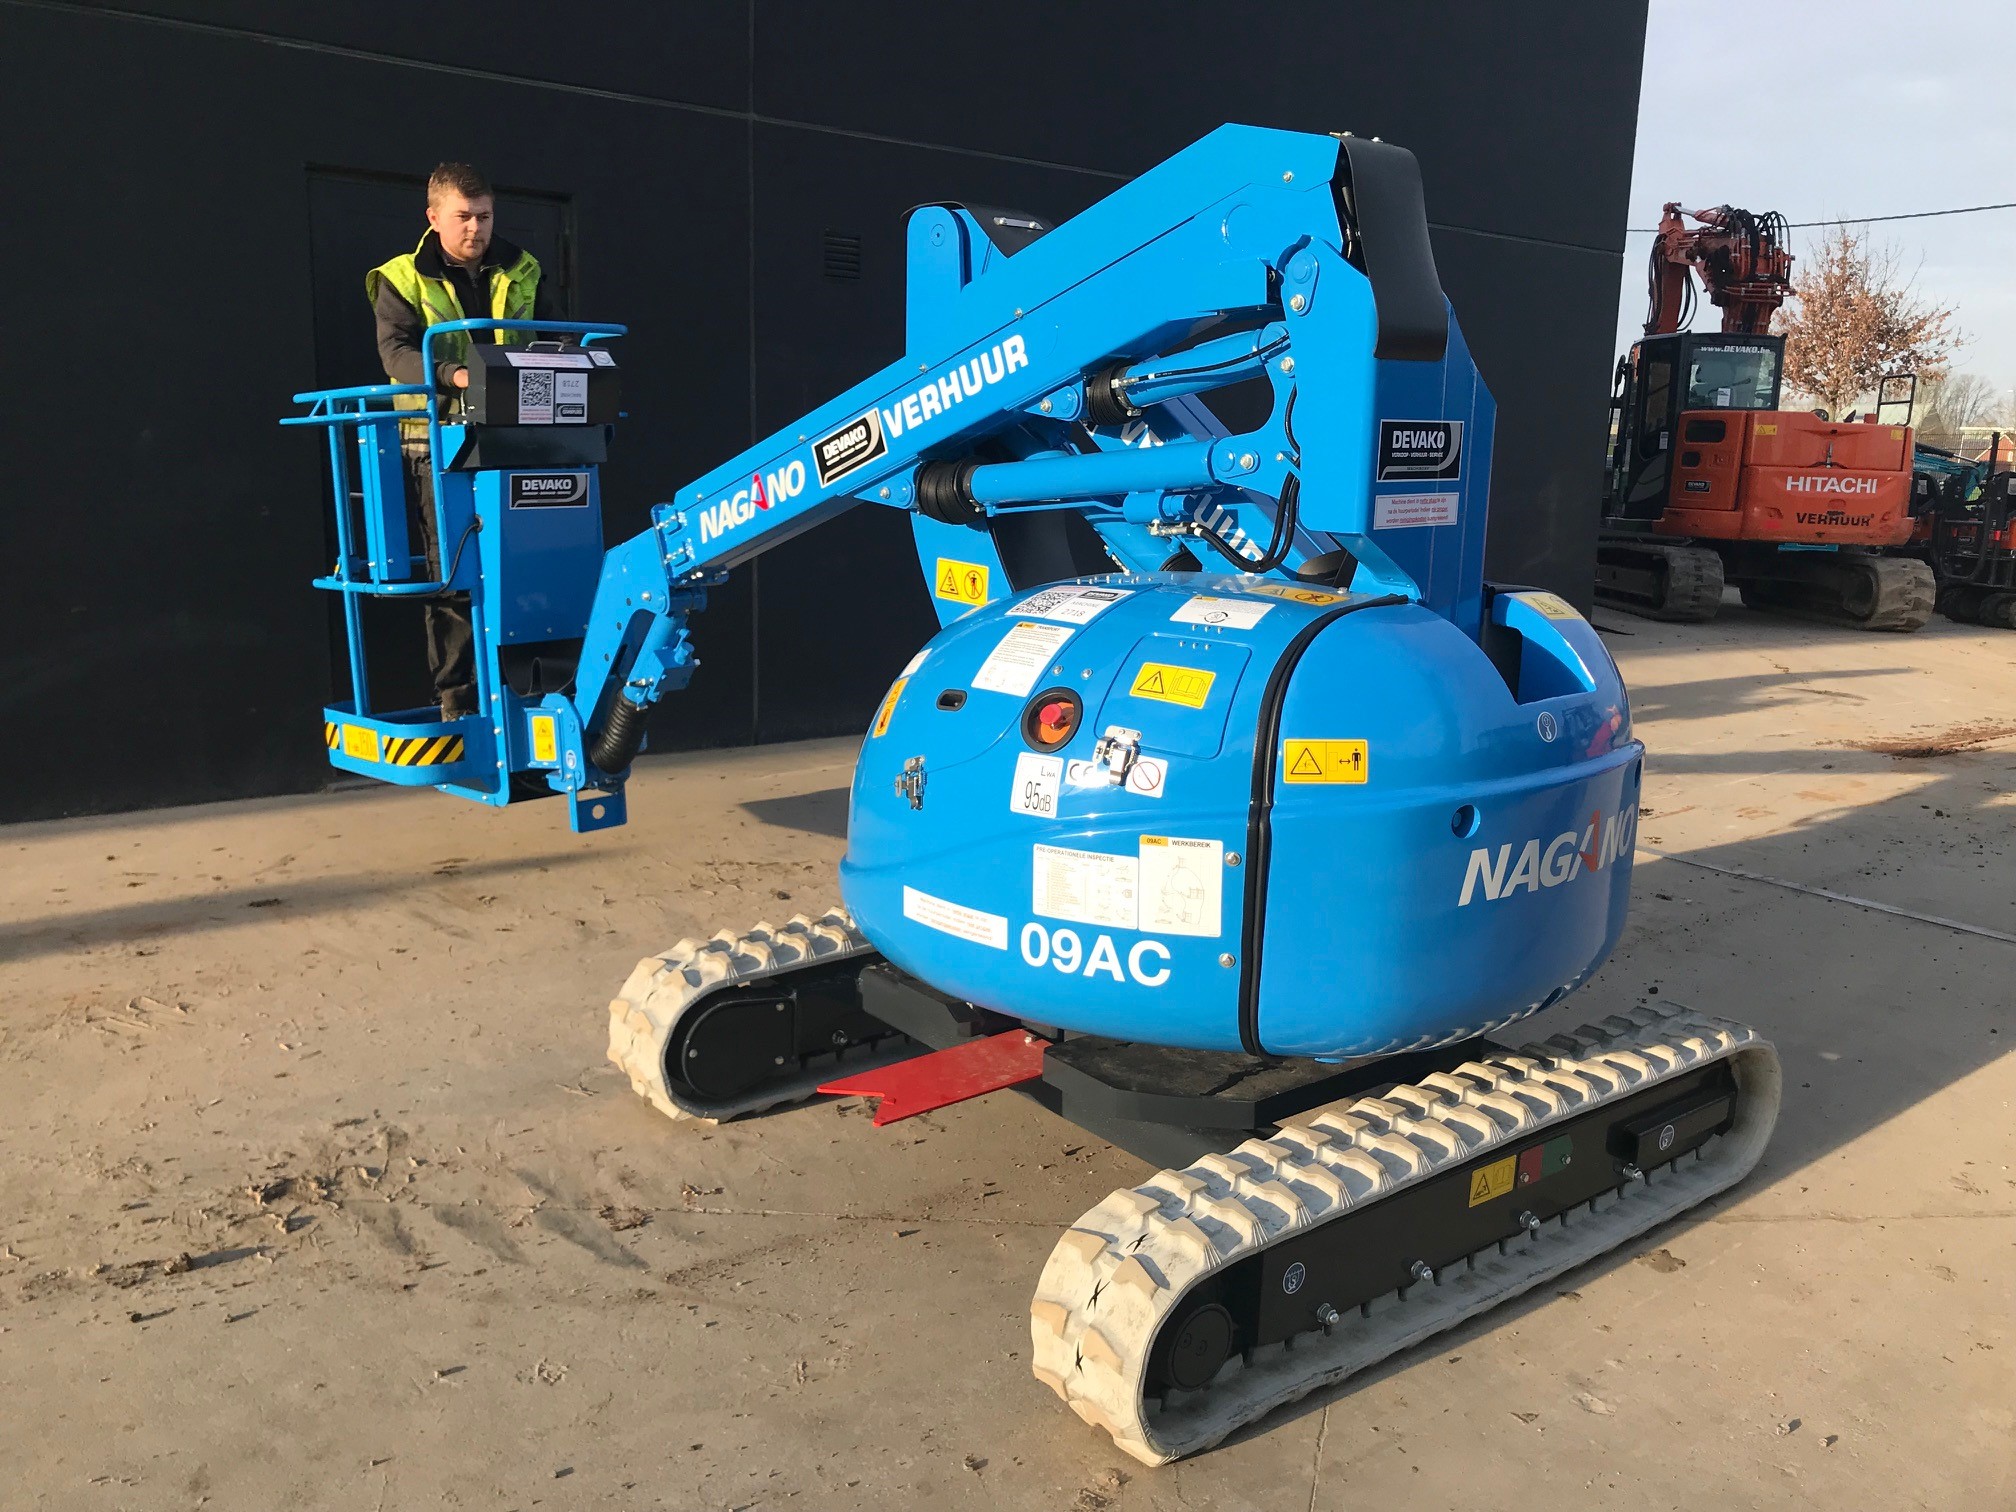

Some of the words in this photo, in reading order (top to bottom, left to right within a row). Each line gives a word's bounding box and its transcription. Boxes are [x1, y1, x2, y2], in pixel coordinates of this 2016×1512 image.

[882, 334, 1029, 438] VERHUUR
[822, 425, 867, 460] DEVAKO
[1391, 430, 1446, 449] DEVAKO
[522, 478, 572, 491] DEVAKO
[1786, 475, 1878, 494] HITACHI
[699, 460, 806, 545] NAGANO
[1146, 837, 1162, 845] 09AC
[1171, 839, 1211, 848] WERKBEREIK
[1457, 803, 1636, 907] NAGANO
[1086, 853, 1115, 863] INSPECTIE
[1020, 922, 1172, 987] 09AC
